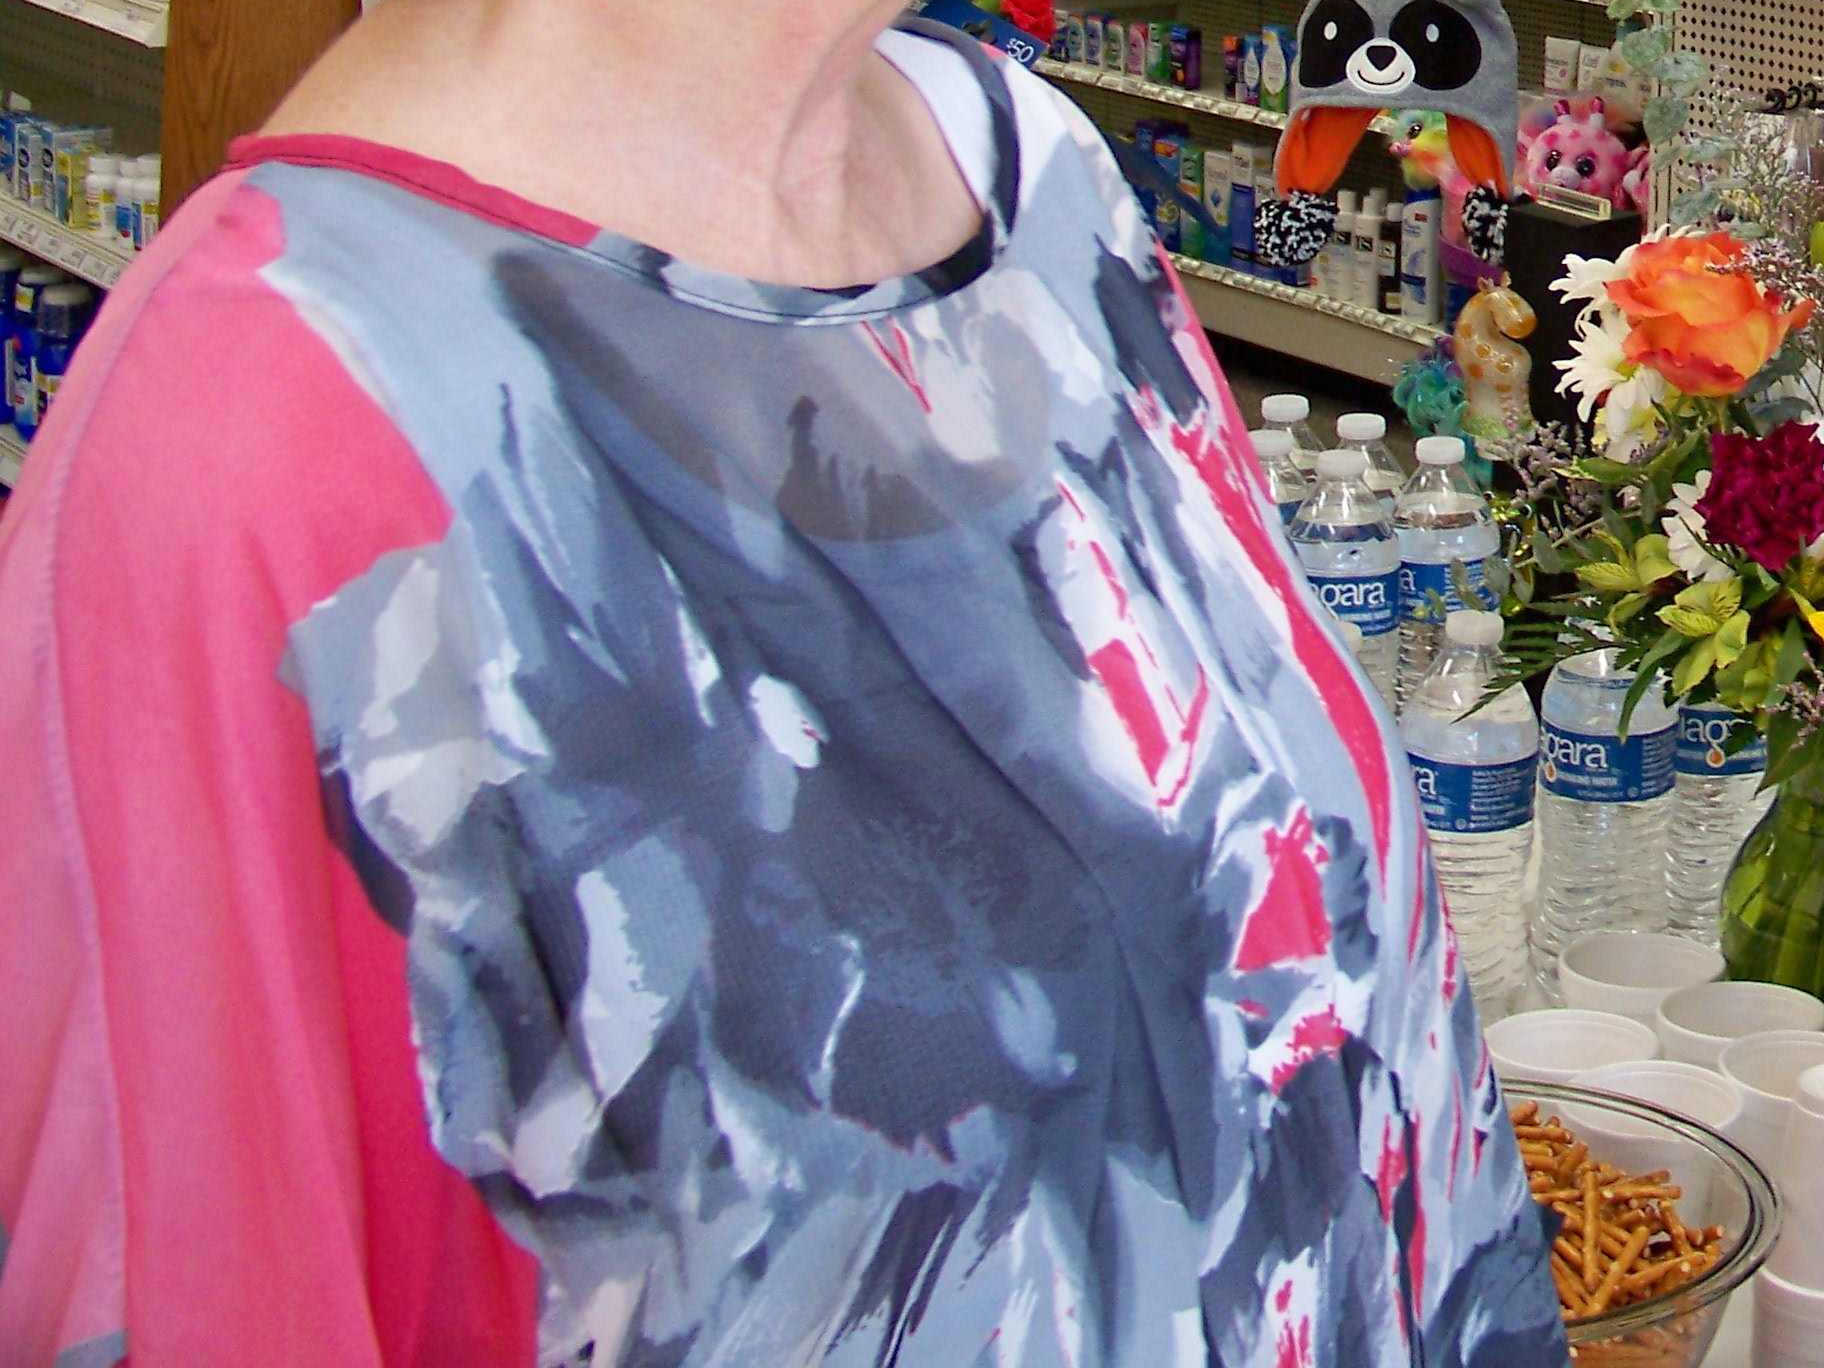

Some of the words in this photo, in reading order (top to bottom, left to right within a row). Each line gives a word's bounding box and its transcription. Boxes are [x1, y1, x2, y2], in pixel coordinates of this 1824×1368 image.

[1006, 37, 1035, 63] $50
[1320, 581, 1386, 609] gara
[1543, 730, 1608, 769] gara
